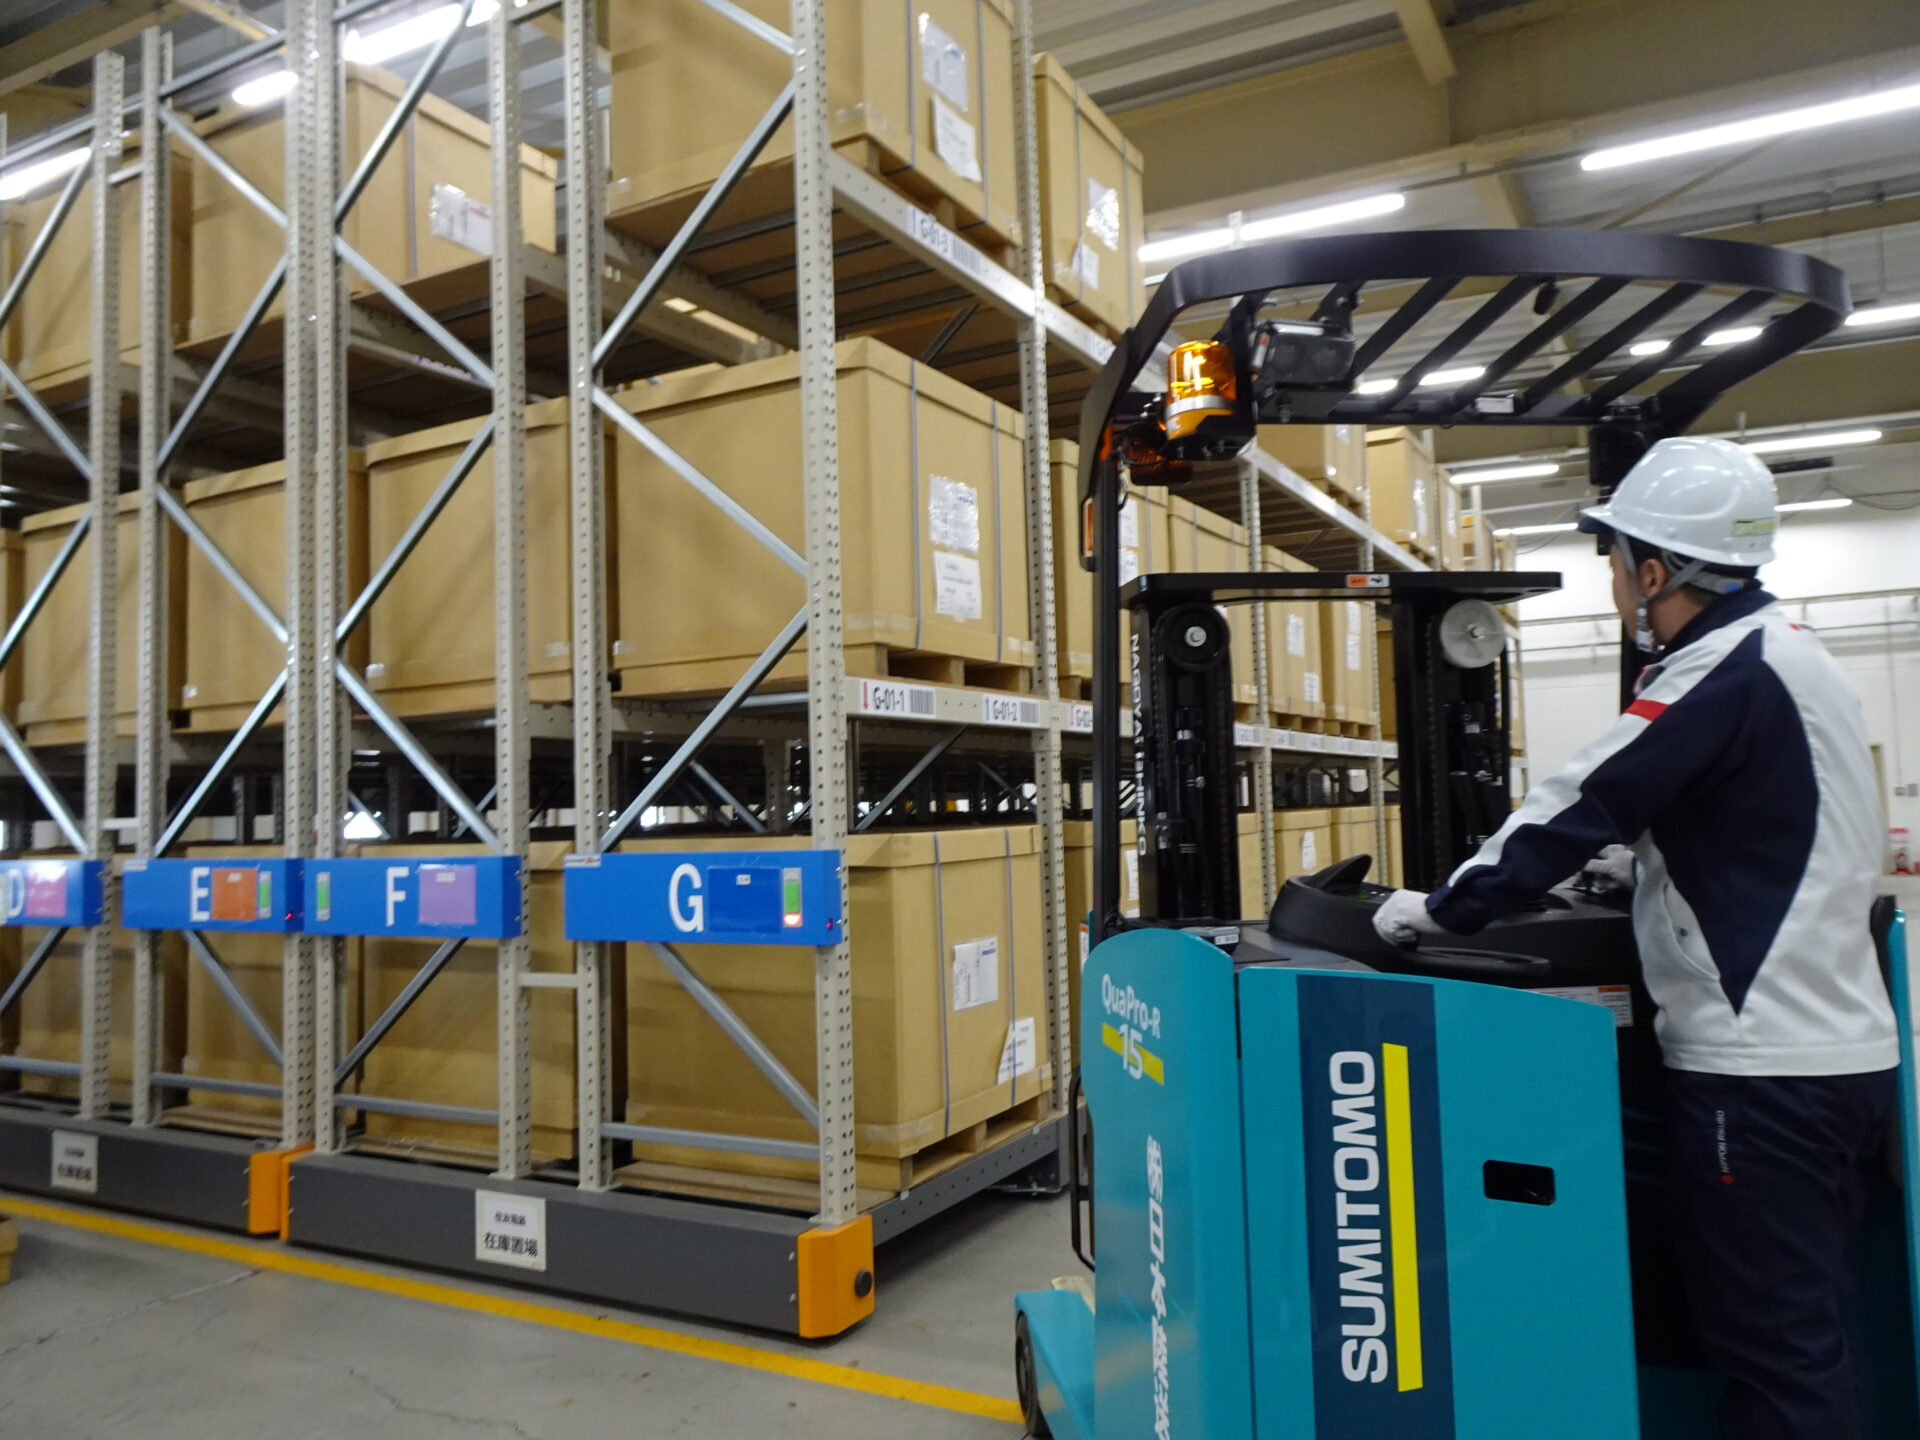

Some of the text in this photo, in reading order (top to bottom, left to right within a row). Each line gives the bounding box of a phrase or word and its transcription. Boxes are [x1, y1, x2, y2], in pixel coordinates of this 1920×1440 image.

[873, 687, 905, 712] G-01-1
[993, 699, 1018, 722] G-01-2
[1130, 633, 1143, 737] NAGOYA
[8, 867, 25, 918] D
[190, 866, 210, 922] E
[385, 866, 409, 928] F
[668, 862, 704, 934] G
[1102, 973, 1161, 1039] QuaPro-R
[1119, 1023, 1144, 1080] 15
[1329, 1050, 1389, 1385] SUMITOMO
